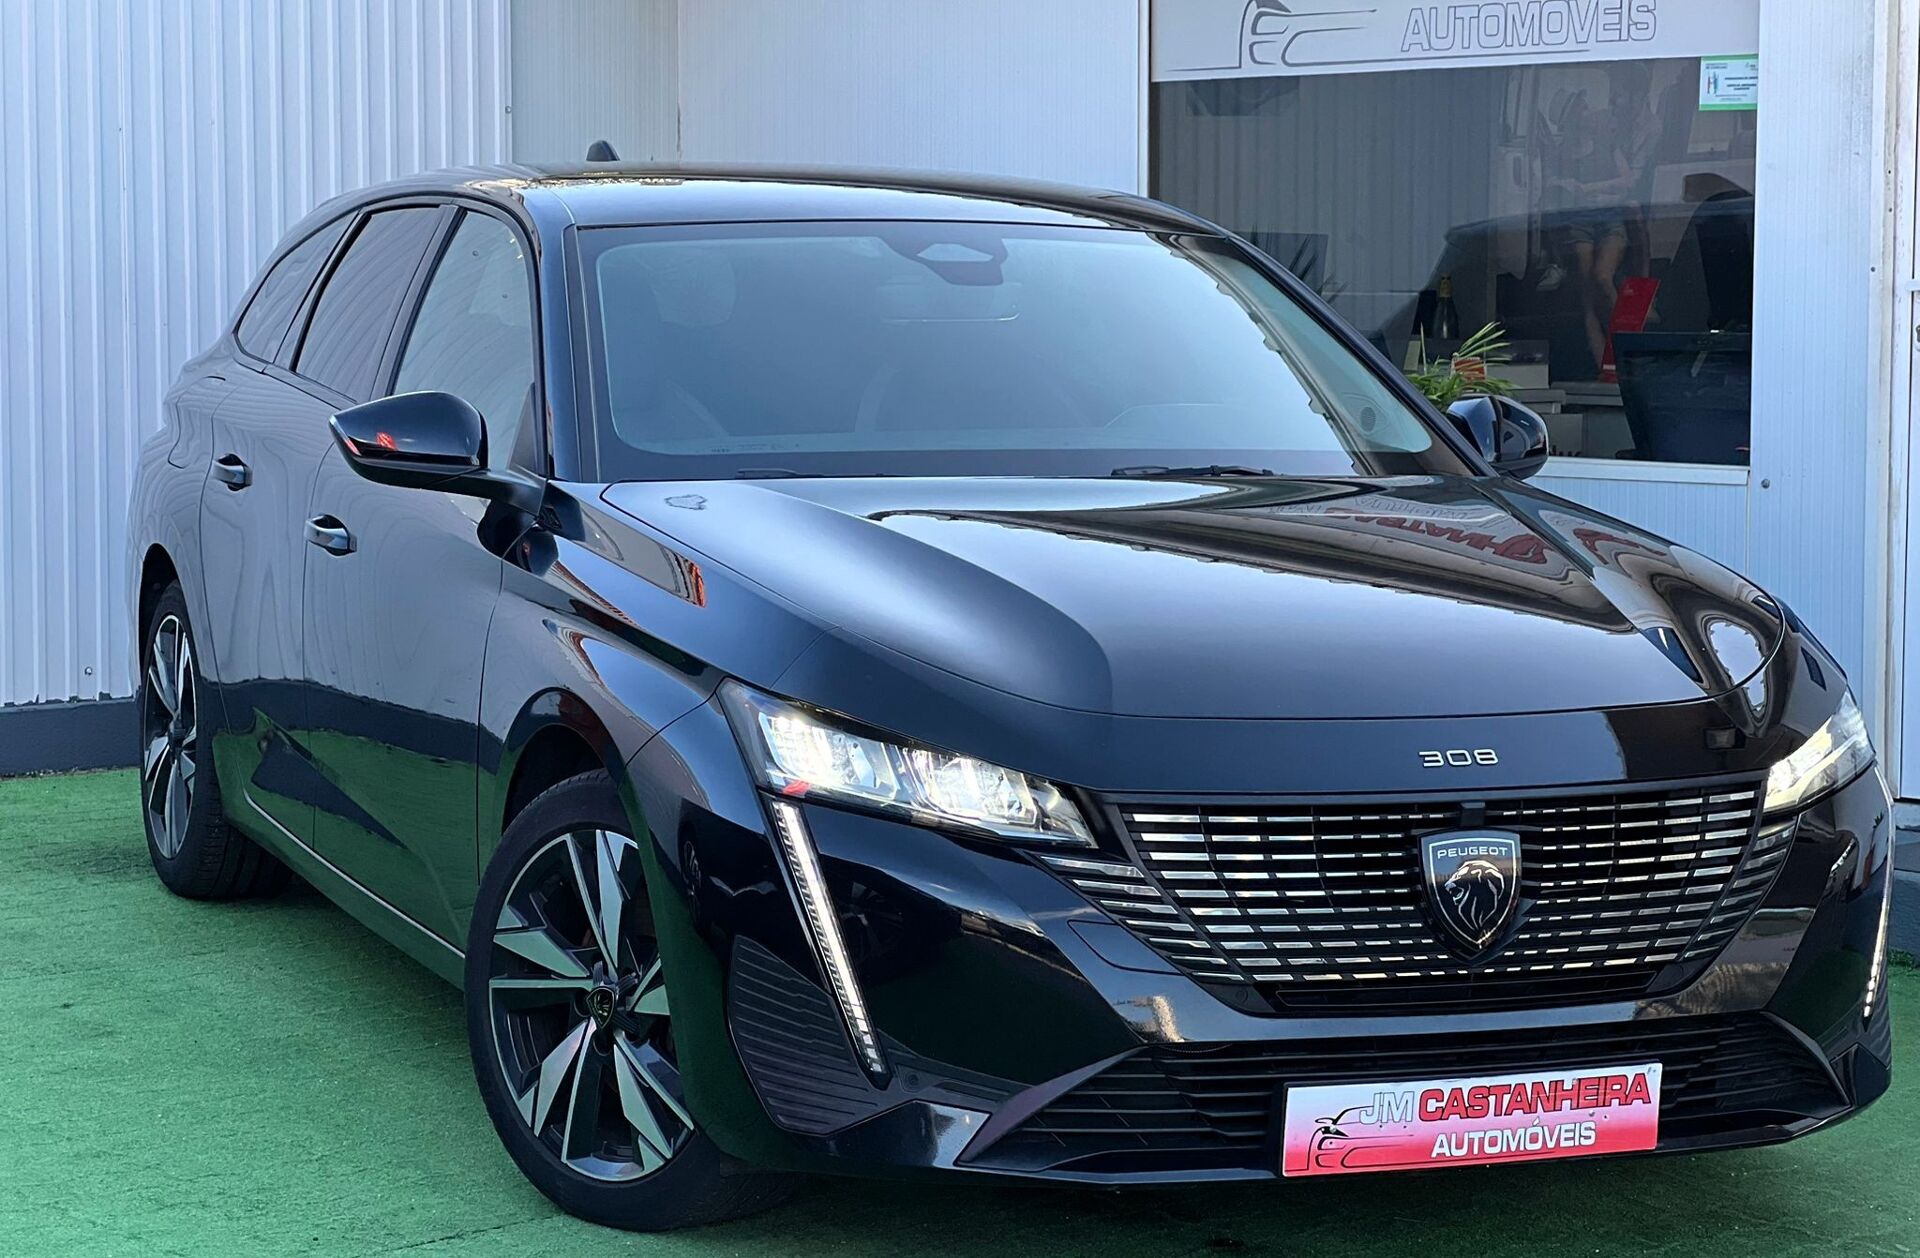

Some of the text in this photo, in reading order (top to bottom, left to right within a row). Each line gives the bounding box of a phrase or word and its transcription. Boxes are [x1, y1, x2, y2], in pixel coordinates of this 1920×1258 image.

[1419, 749, 1499, 767] 308
[1437, 846, 1508, 859] PEUGEOT
[1359, 1073, 1651, 1125] JM CASTANHEIRA
[1431, 1116, 1596, 1158] AUTOMÓVEIS
